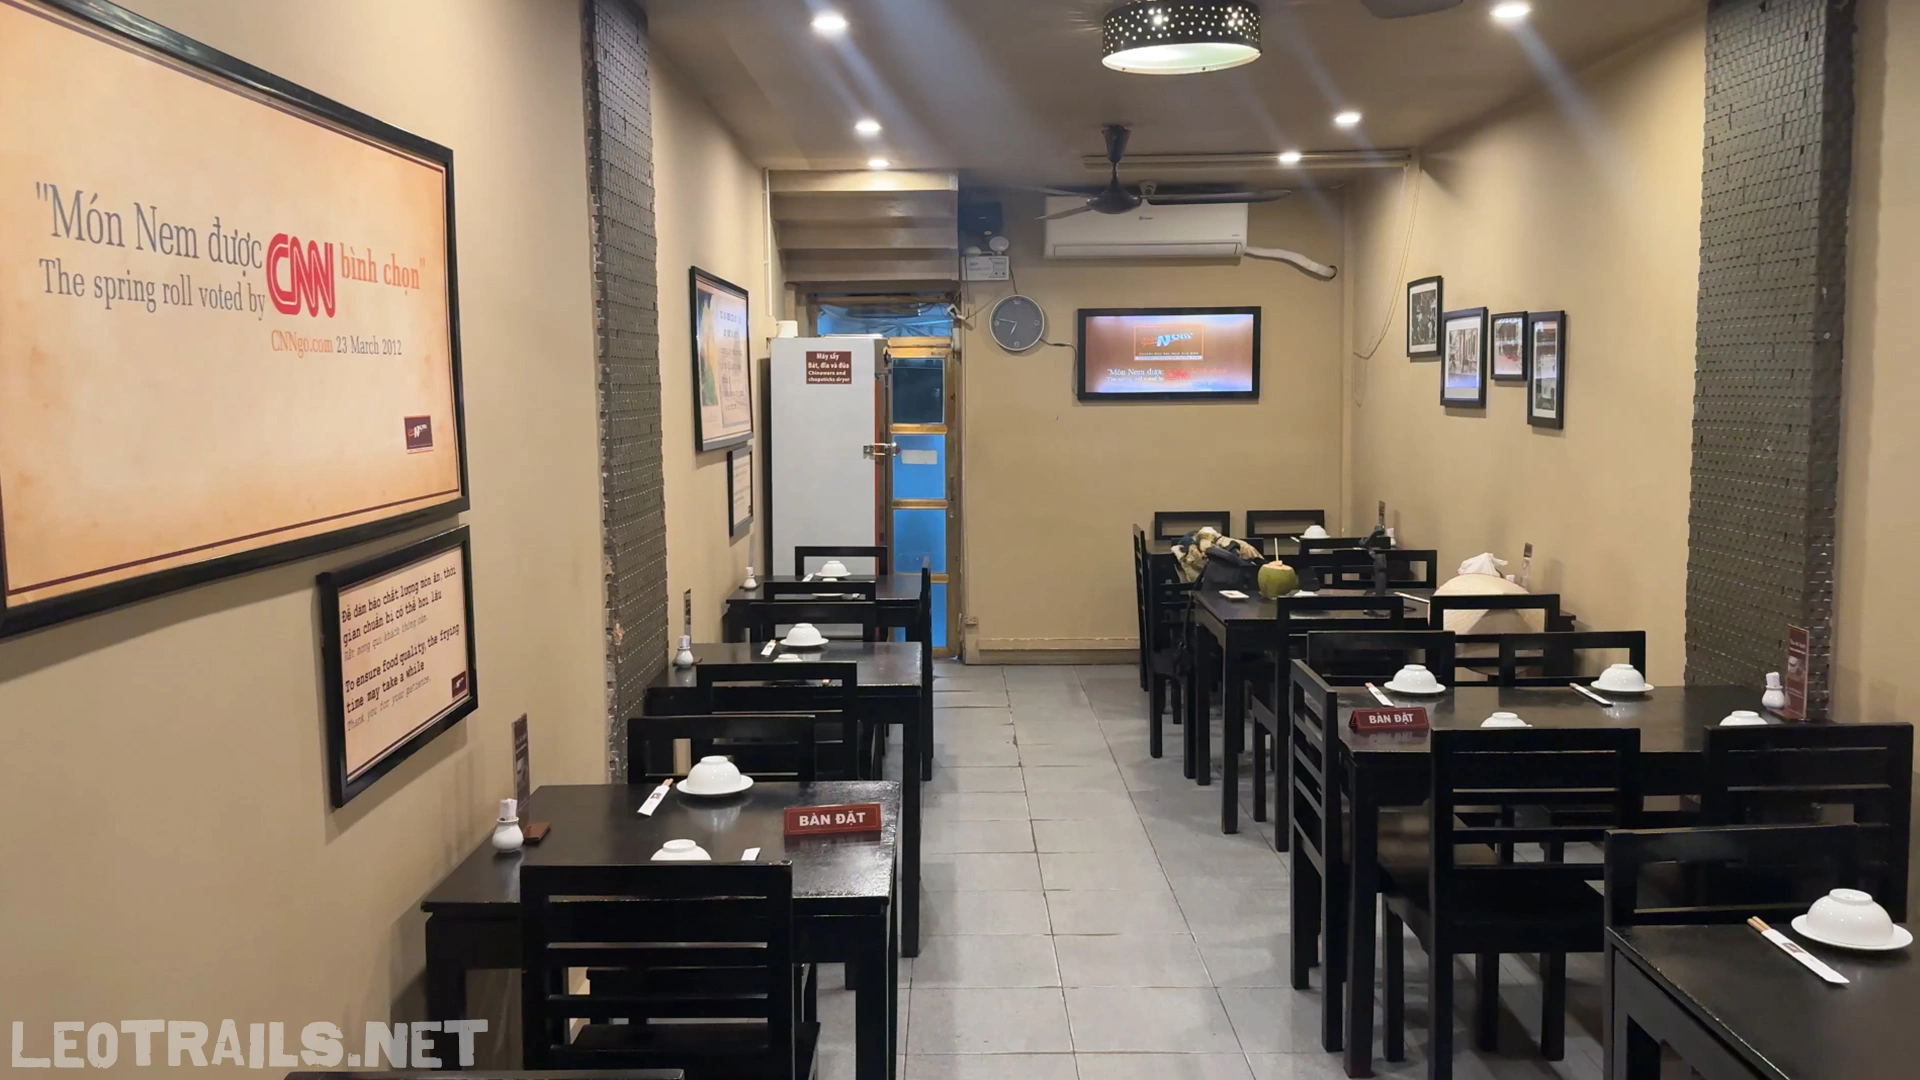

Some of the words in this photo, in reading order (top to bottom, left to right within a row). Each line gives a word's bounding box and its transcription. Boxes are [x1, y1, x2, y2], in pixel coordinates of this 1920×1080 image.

[36, 181, 126, 248] "Món
[133, 201, 200, 259] Nem
[207, 215, 263, 277] được
[266, 232, 336, 318] CNN
[339, 242, 379, 284] bình
[39, 257, 86, 297] The
[93, 269, 157, 314] spring
[162, 273, 194, 307] roll
[198, 281, 244, 312] voted
[246, 282, 266, 322] by
[271, 329, 334, 359] CNNgo.com
[336, 335, 348, 354] 23
[350, 334, 380, 355] March
[382, 338, 403, 356] 2012
[342, 628, 361, 648] gian
[344, 680, 355, 694] To
[355, 666, 381, 688] ensure
[382, 653, 399, 673] food
[399, 641, 427, 666] quality,
[427, 634, 438, 648] the
[439, 623, 460, 642] frying
[346, 696, 364, 714] time
[366, 686, 381, 701] may
[382, 674, 399, 693] take
[405, 660, 425, 679] while
[347, 714, 365, 731] Thank
[366, 706, 378, 722] you
[379, 698, 391, 712] for
[391, 690, 406, 707] your
[1369, 712, 1392, 724] BÀN
[1394, 711, 1414, 725] ĐẶT
[799, 812, 831, 827] BÀN
[835, 809, 866, 826] ĐẶT
